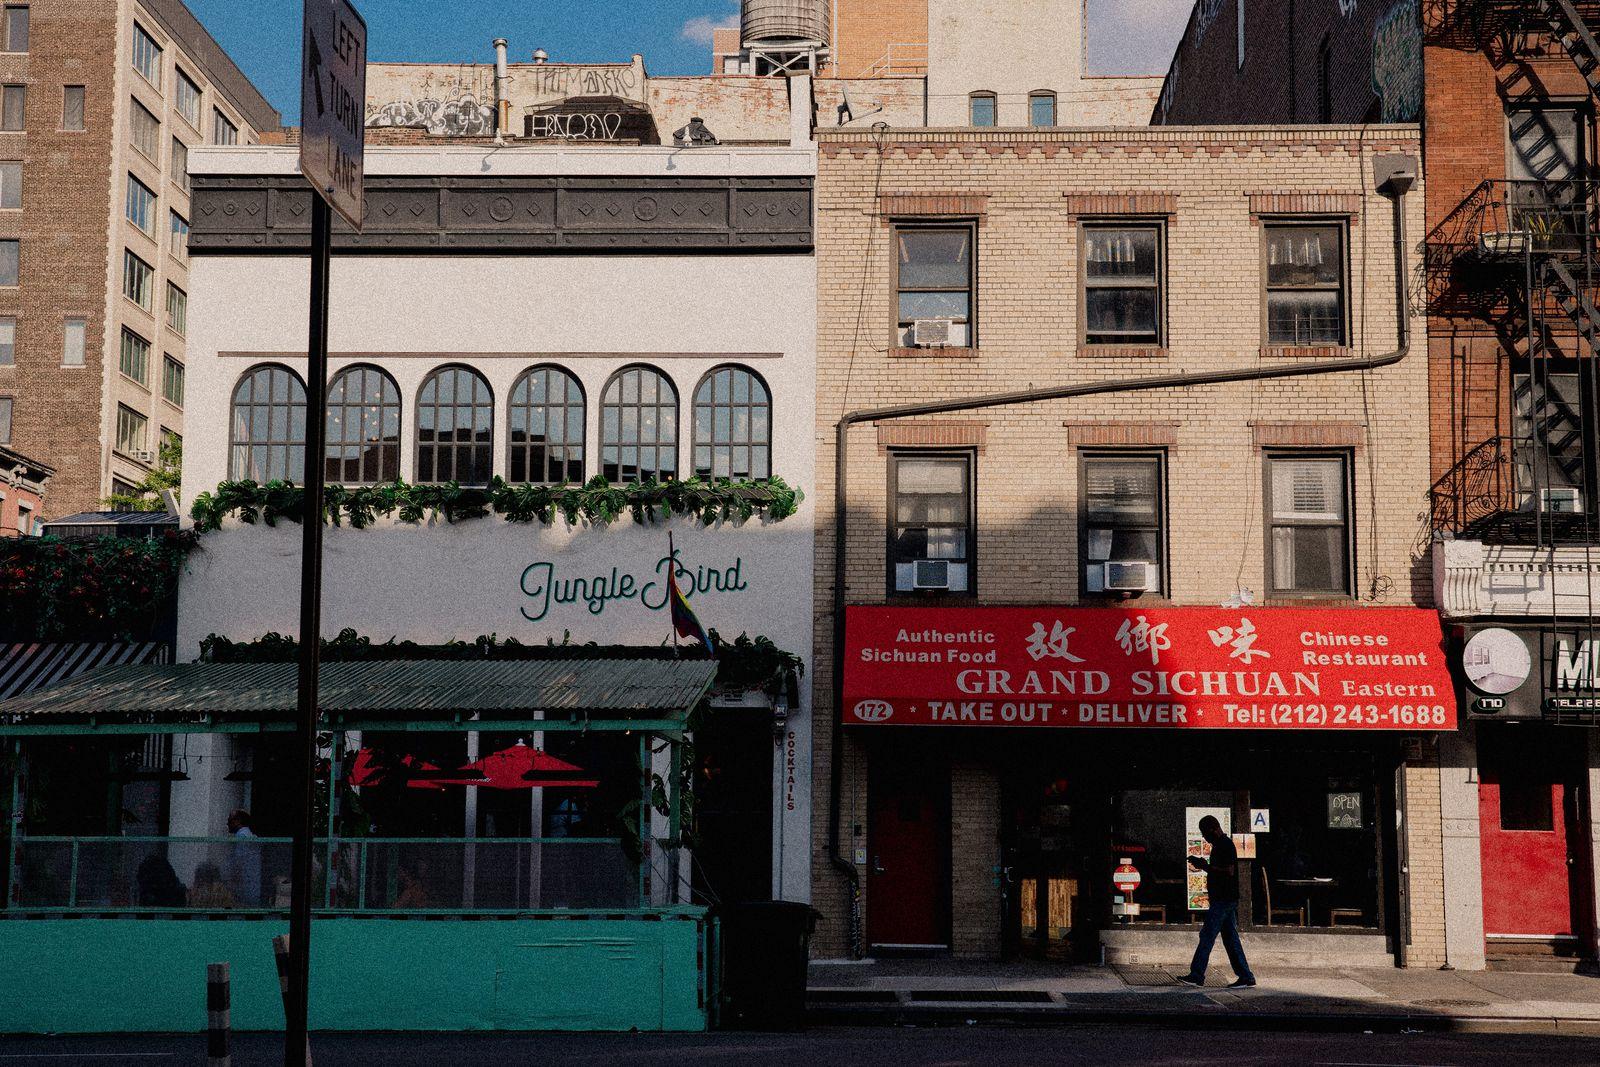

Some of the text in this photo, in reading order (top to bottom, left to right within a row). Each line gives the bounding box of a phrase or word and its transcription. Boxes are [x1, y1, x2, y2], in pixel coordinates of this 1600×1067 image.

[332, 10, 360, 77] LEFT
[329, 70, 359, 140] TURN
[327, 136, 357, 201] LANE
[520, 550, 747, 621] Jungle Bird
[896, 629, 995, 643] Authentic
[1301, 631, 1388, 647] Chinese
[861, 648, 997, 664] Sichuan Food
[1303, 651, 1427, 668] Restaurant
[956, 669, 1320, 696] GRAND SICHUAN
[1342, 681, 1437, 697] Eastern
[858, 703, 888, 718] 172
[1481, 698, 1503, 708] 170
[928, 701, 1447, 725] TAKE OUT DELIVER Tel: (212) 243-1688
[787, 732, 795, 811] COCKTAILS
[1332, 794, 1361, 810] OPEN
[1254, 812, 1266, 826] A
